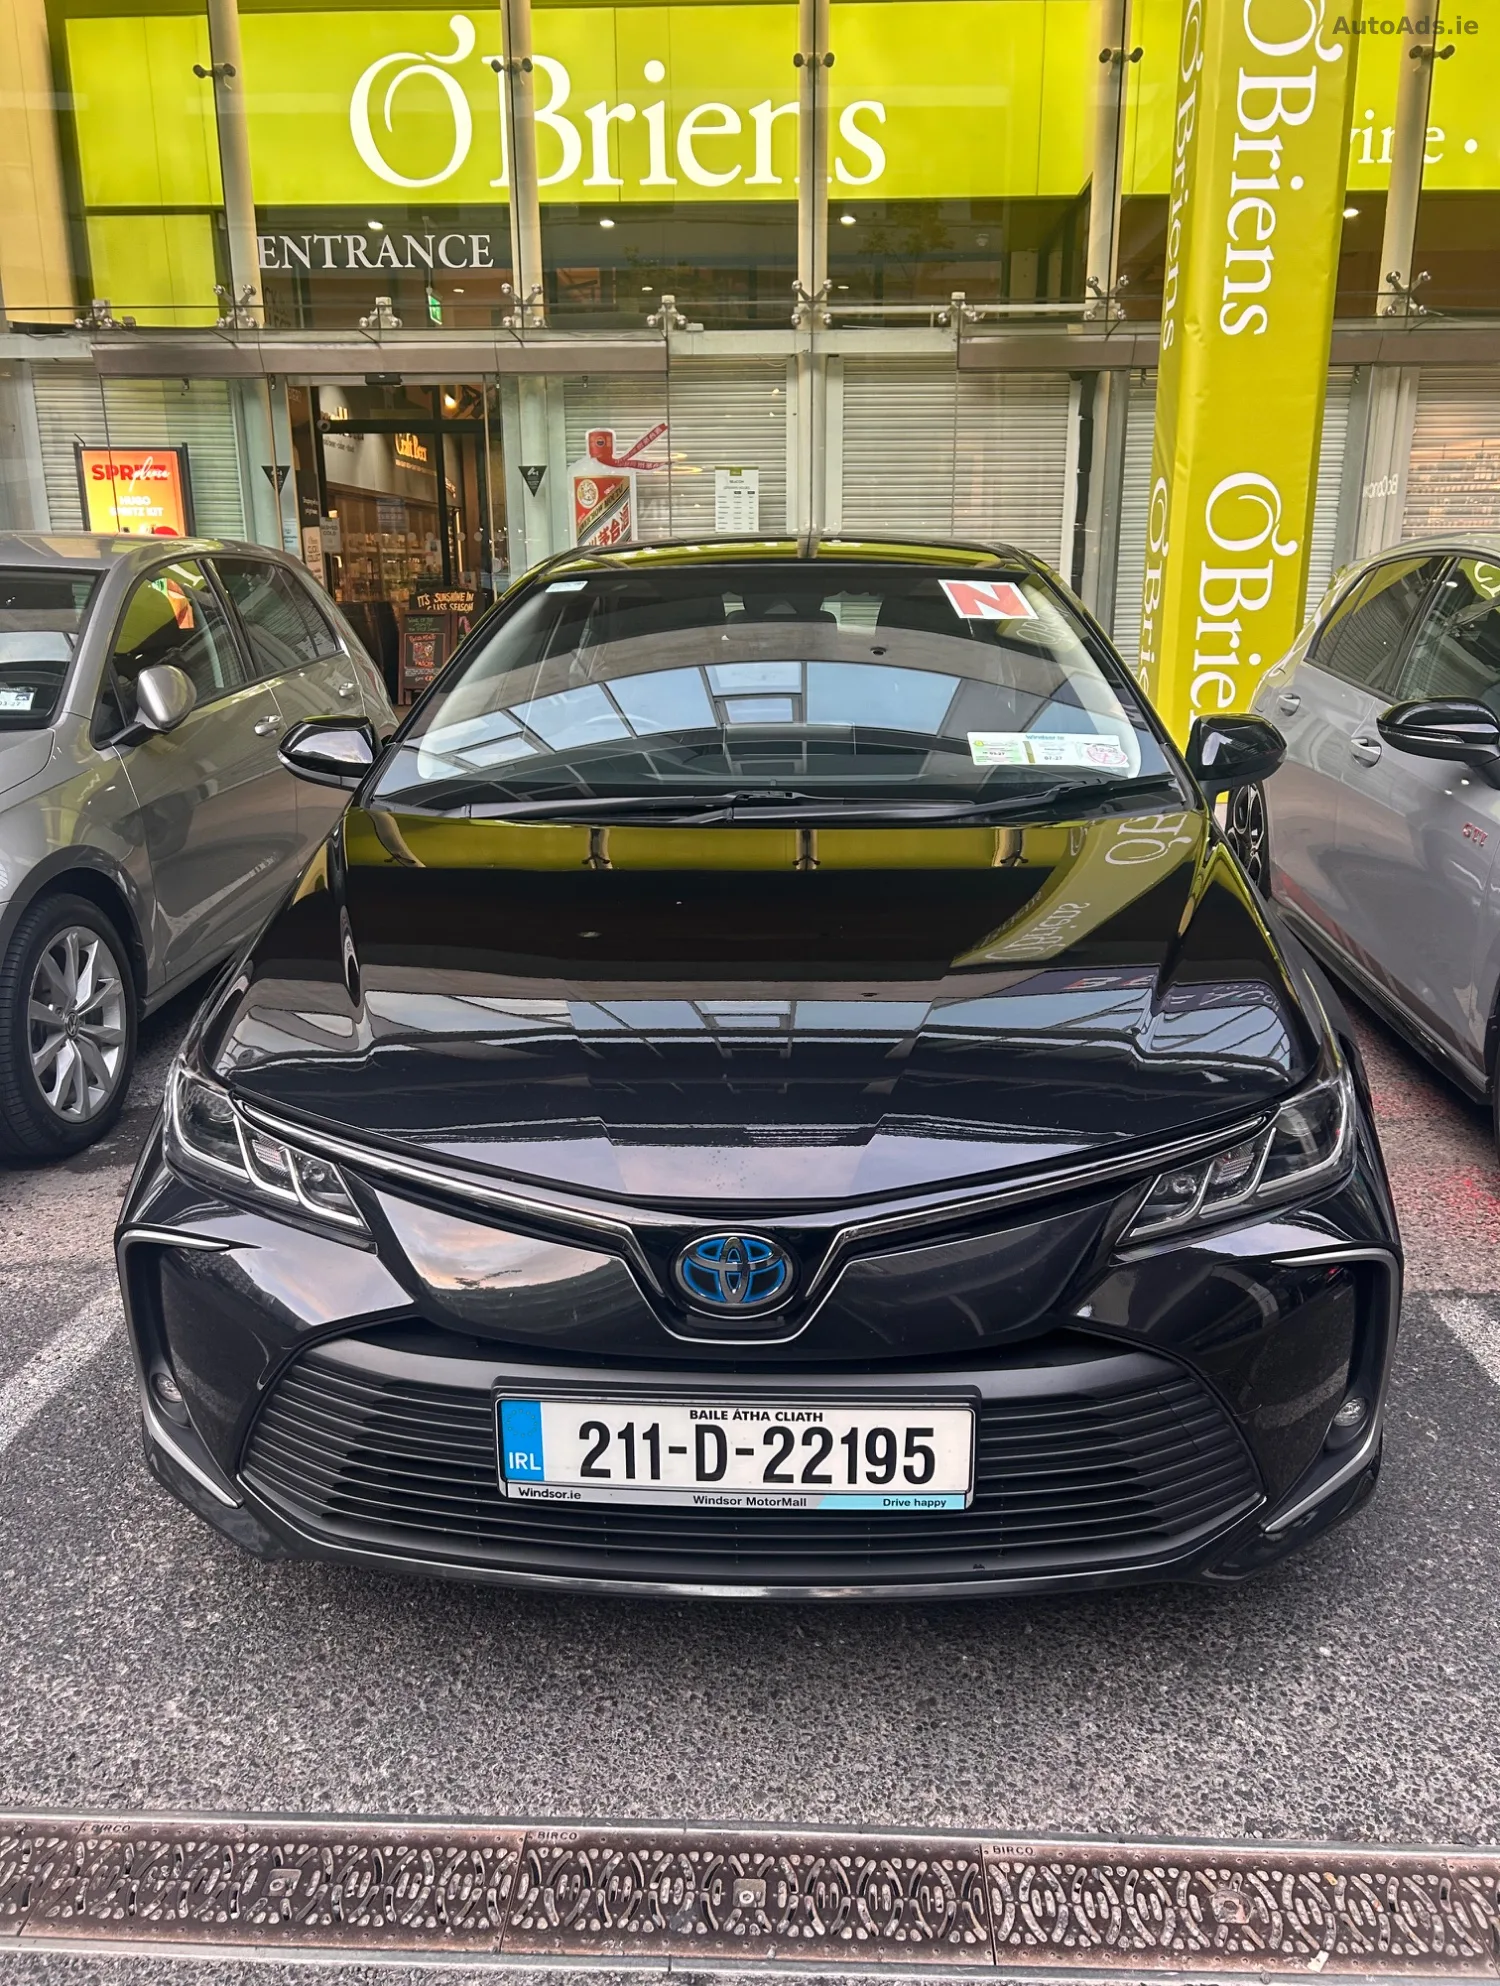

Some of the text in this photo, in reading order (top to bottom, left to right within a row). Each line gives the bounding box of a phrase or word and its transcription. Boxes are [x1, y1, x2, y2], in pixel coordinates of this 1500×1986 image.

[350, 14, 887, 188] O'Briens
[1220, 0, 1343, 336] O'Briens
[257, 234, 494, 269] ENTRANCE
[146, 507, 164, 517] KIT
[417, 593, 431, 608] IT'S
[945, 582, 1030, 617] N
[1188, 472, 1299, 731] O'Brie
[1463, 822, 1489, 847] GTI
[690, 1408, 823, 1422] BAILE ÁTHA CLIATH
[578, 1420, 936, 1485] 211-D-22195
[509, 1452, 542, 1471] IRL
[518, 1487, 582, 1500] Windsor.ie
[693, 1495, 807, 1507] Windsor MotorMall
[883, 1498, 947, 1508] Drive happy
[538, 1831, 578, 1840] BIRCO
[992, 1845, 1034, 1856] BIRCO
